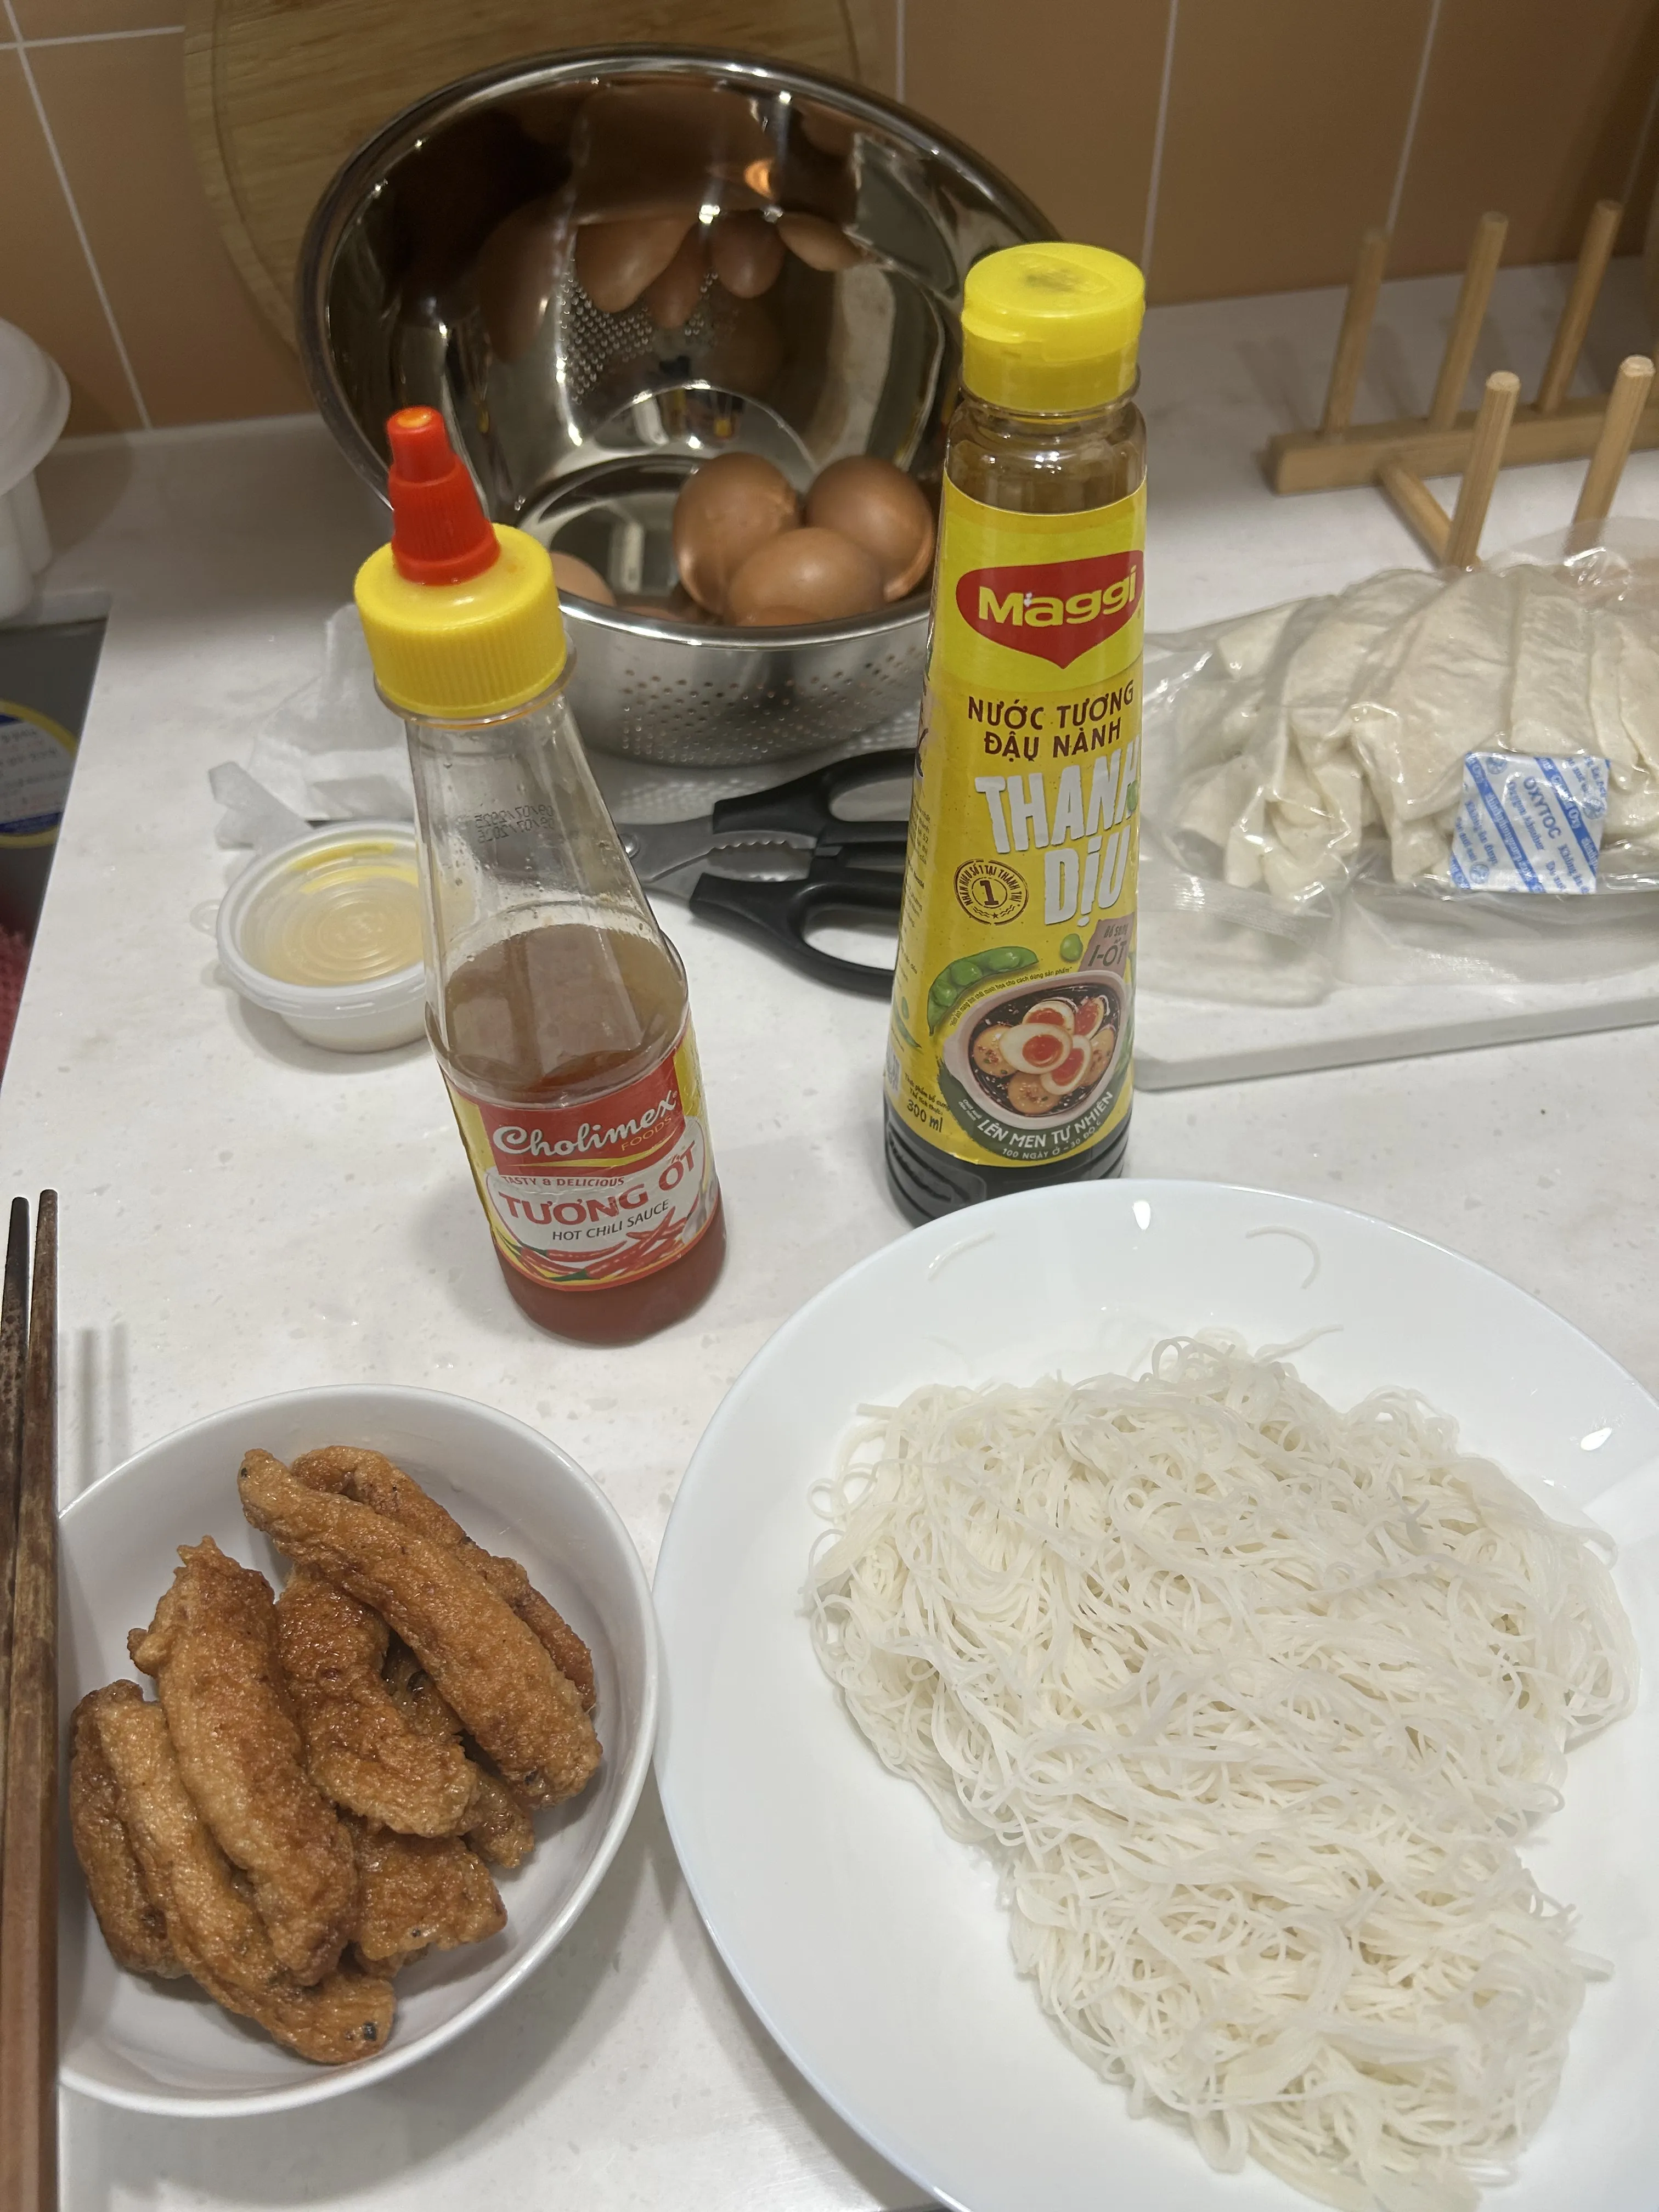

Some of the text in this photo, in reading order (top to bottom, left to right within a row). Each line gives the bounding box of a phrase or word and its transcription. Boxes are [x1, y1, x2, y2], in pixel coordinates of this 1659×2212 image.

[978, 565, 1137, 628] Maggi
[968, 679, 1135, 730] NƯỚC TƯƠNG
[984, 716, 1121, 762] ĐẬU NÀNH
[974, 733, 1140, 855] THANH
[1523, 775, 1562, 839] OXYTOC
[978, 865, 984, 874] 1
[984, 865, 997, 876] TẠI
[980, 879, 1000, 906] 1
[1016, 975, 1029, 984] cách
[493, 1090, 677, 1156] Cholimex
[620, 1115, 673, 1152] FOODS
[907, 1099, 943, 1132] 300 ml
[977, 1091, 1113, 1148] LÊN MEN TỰ NHIÊN
[1002, 1148, 1018, 1158] 100
[1070, 1138, 1081, 1148] 30
[498, 1140, 696, 1226] TƯƠNG ỚT
[501, 1176, 625, 1187] TASTY & DELICIOUS
[552, 1199, 669, 1242] HOT CHILI SAUCE
